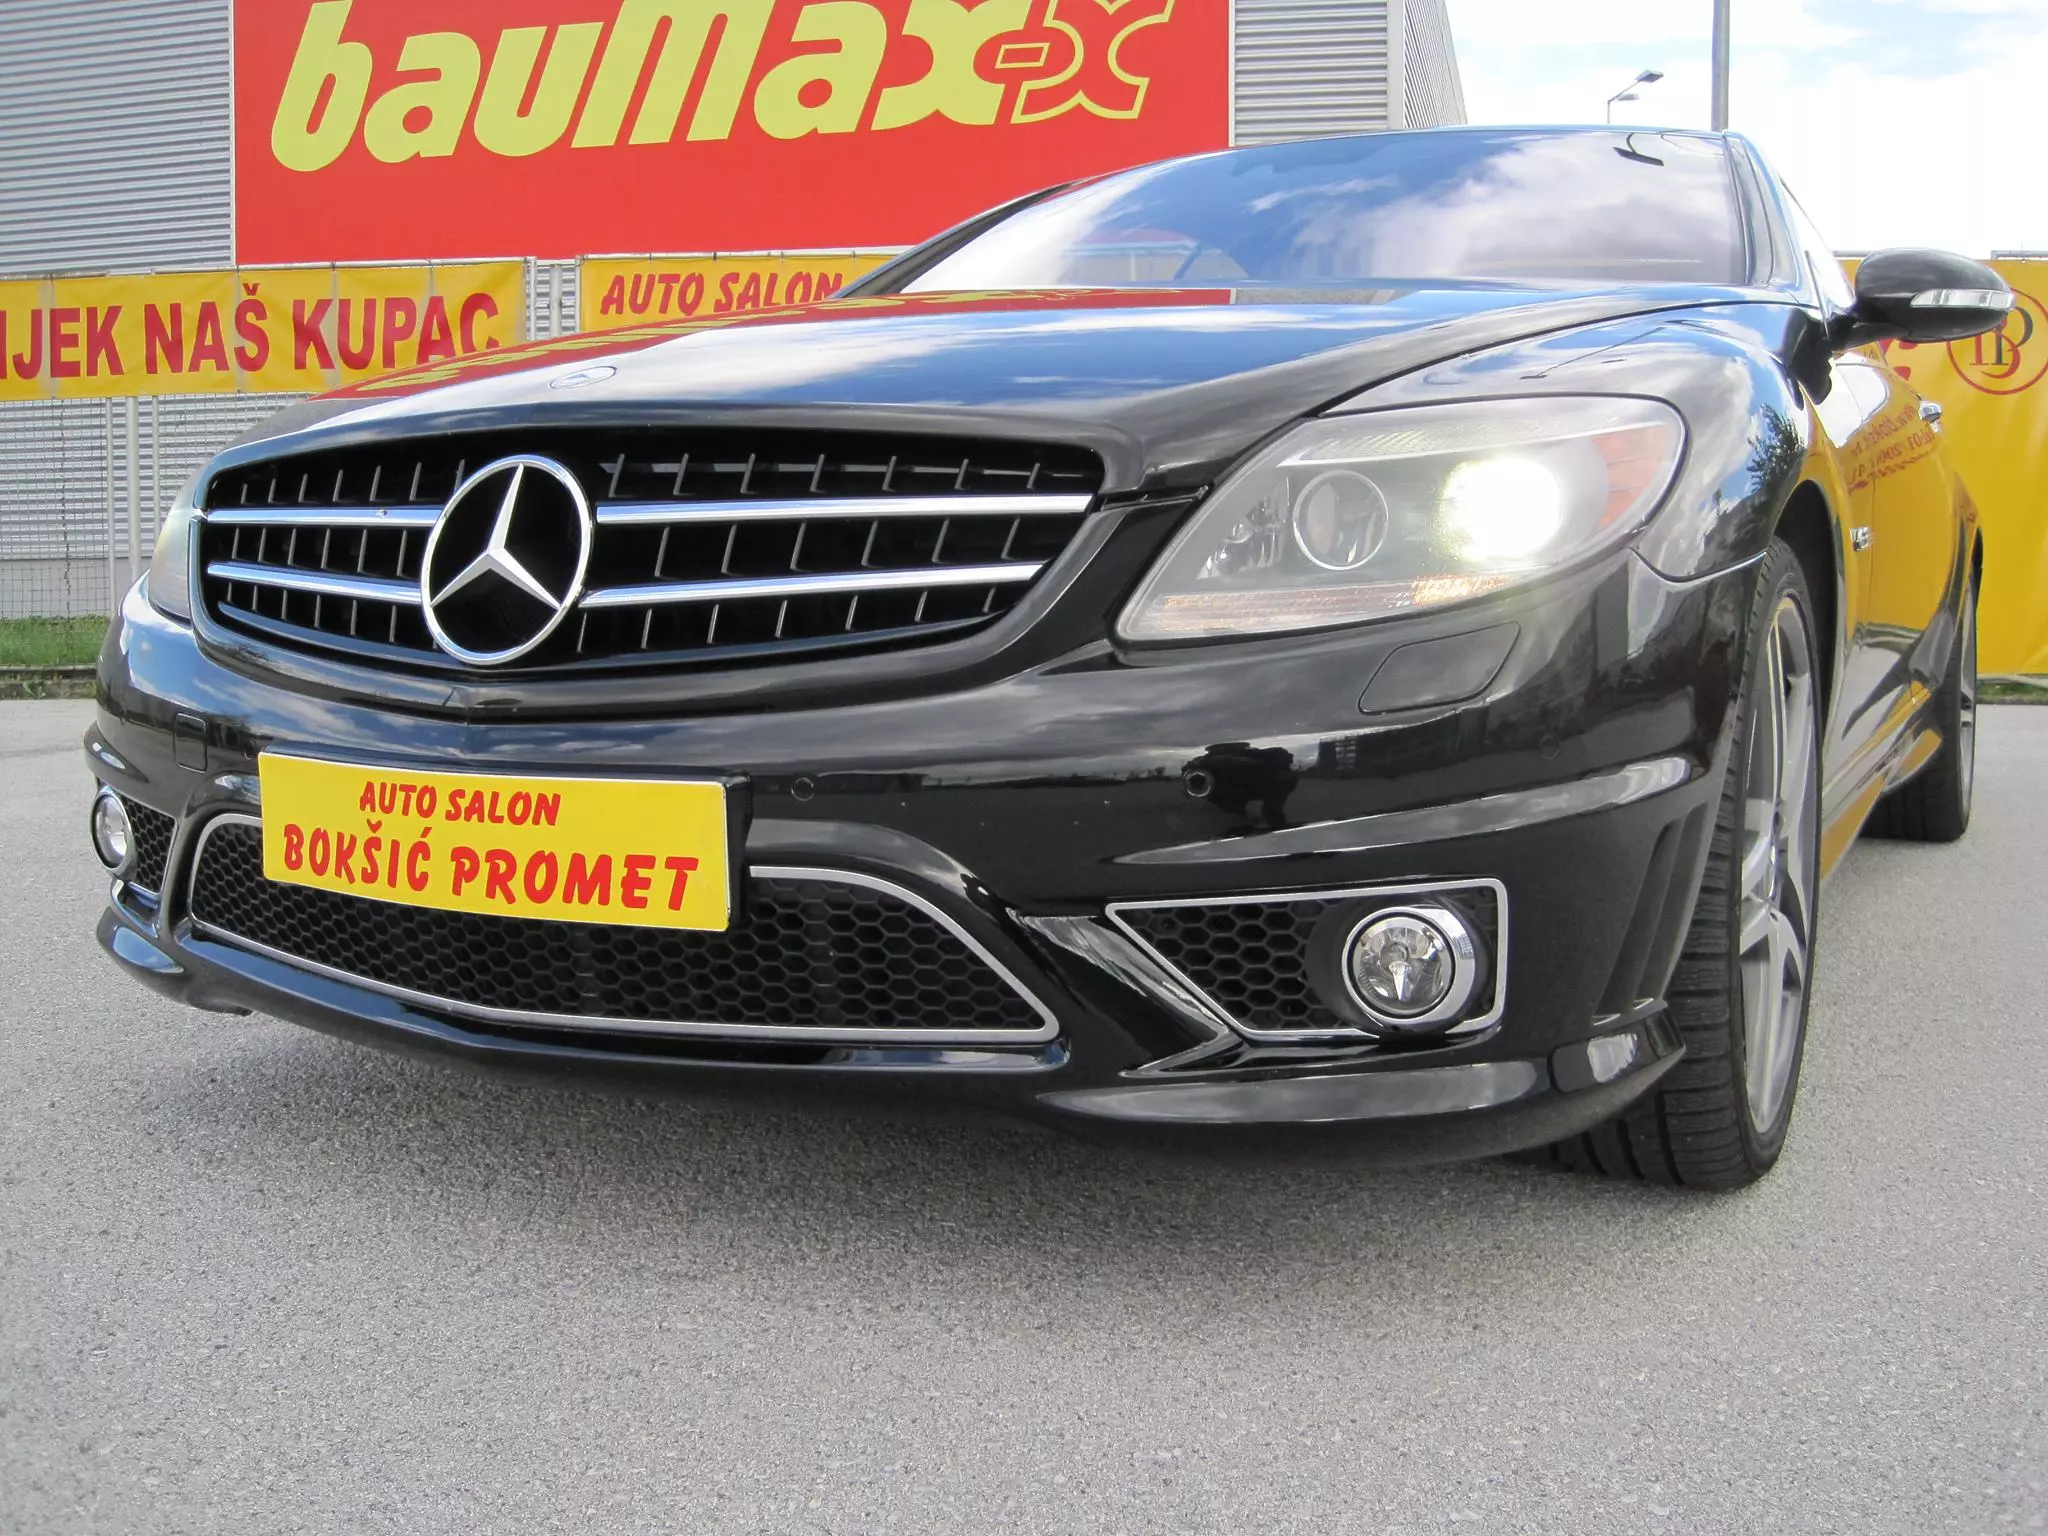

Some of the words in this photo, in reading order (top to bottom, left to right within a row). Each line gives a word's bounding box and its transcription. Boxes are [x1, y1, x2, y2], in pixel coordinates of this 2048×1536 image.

[600, 272, 704, 316] AUTO
[713, 271, 843, 313] SALON
[144, 284, 270, 375] NAŠ
[292, 293, 499, 370] KUPAC
[360, 781, 437, 819] AUTO
[446, 789, 561, 826] SALON
[284, 820, 432, 892] BOKŠIĆ
[450, 846, 699, 911] PROMET
